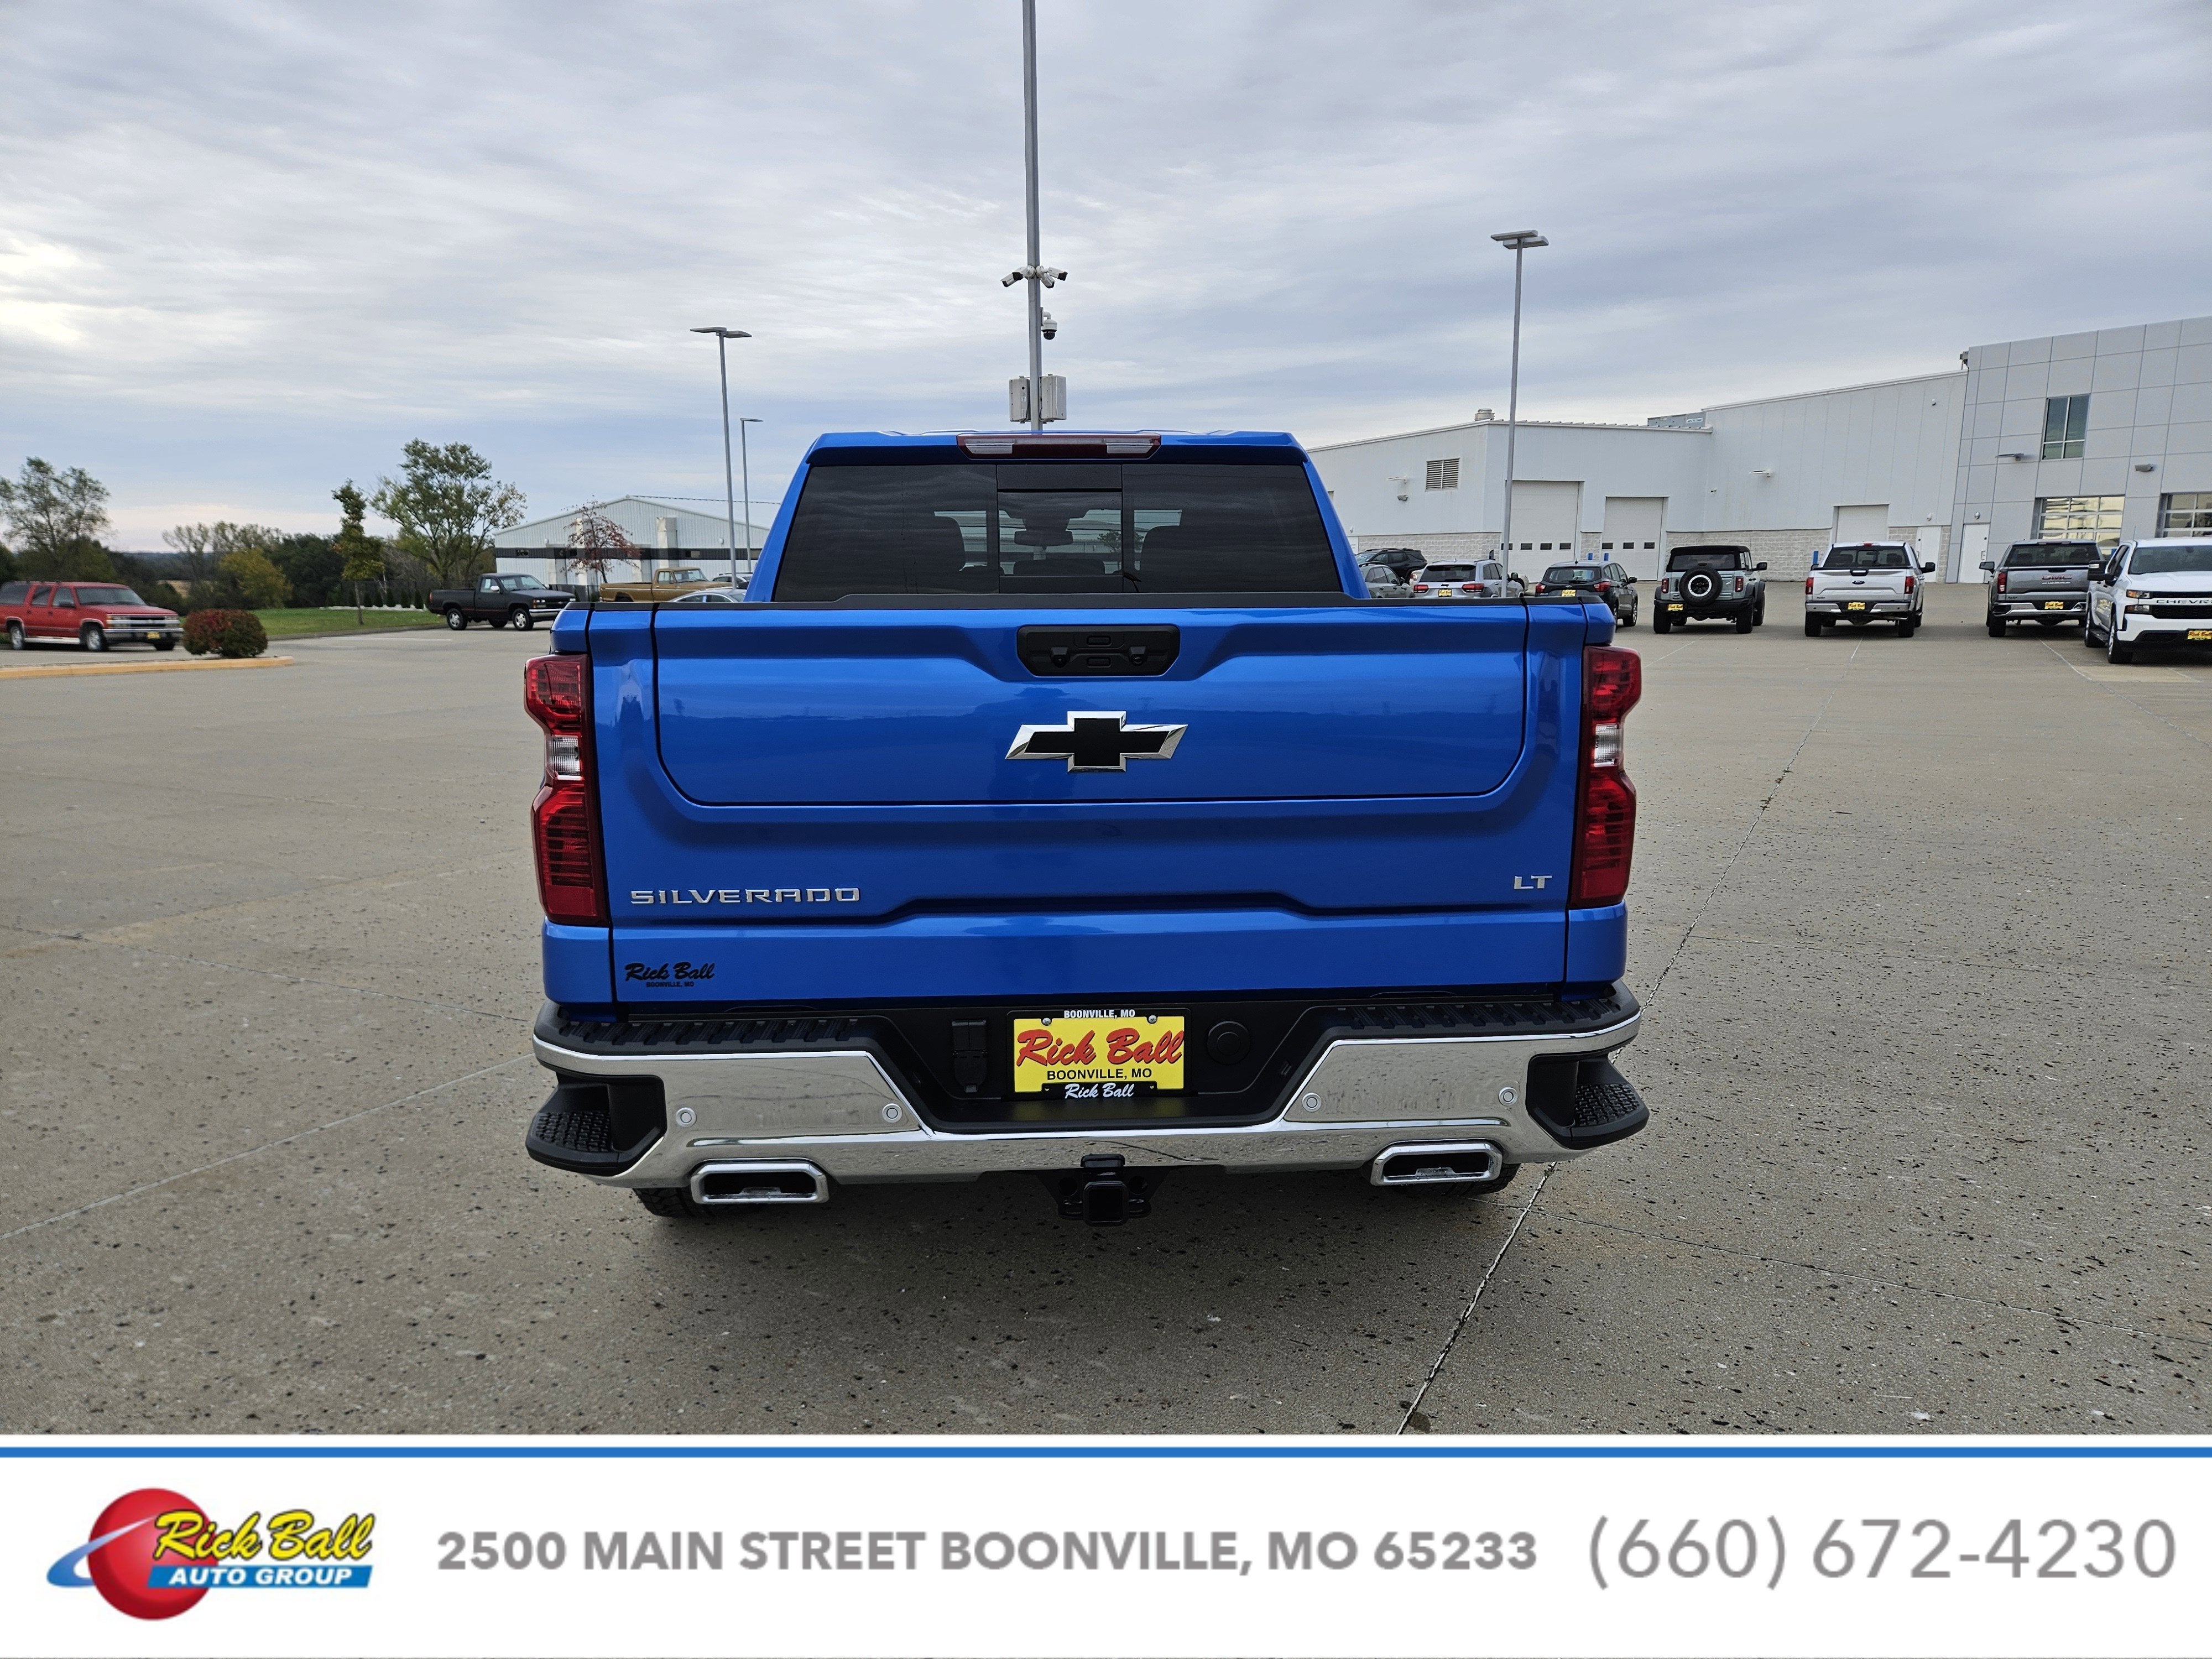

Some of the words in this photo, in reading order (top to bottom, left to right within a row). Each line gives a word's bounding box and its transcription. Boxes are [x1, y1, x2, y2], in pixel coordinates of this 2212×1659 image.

[1514, 875, 1552, 889] LT
[630, 888, 860, 904] SILVERADO
[624, 962, 670, 982] Rick
[673, 961, 715, 979] Ball
[1063, 1010, 1118, 1019] BOONVILLE,
[1120, 1009, 1135, 1018] MO
[1016, 1029, 1097, 1067] Rick
[1106, 1027, 1185, 1065] Ball
[1047, 1069, 1128, 1080] BOONVILLE,
[1131, 1068, 1152, 1078] MO
[1064, 1083, 1099, 1099] Rick
[1103, 1082, 1135, 1098] Ball
